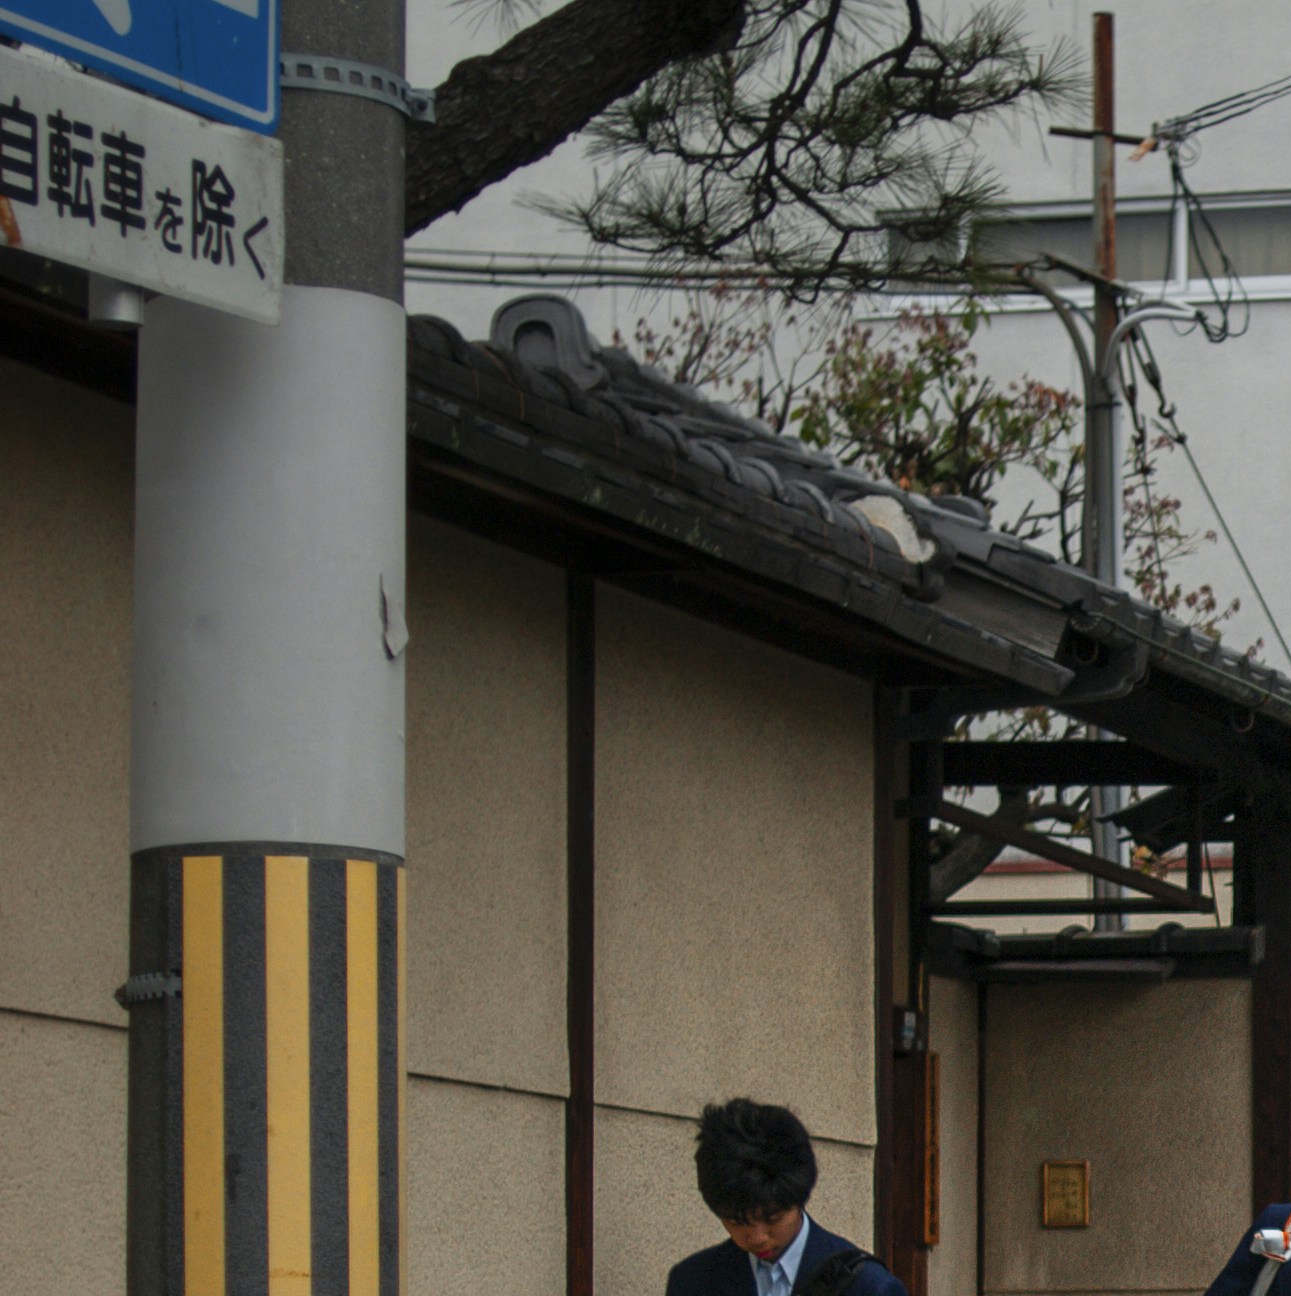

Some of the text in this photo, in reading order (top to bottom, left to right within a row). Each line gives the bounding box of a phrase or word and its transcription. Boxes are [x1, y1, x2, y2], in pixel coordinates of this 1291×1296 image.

[0, 95, 269, 281] 自転車を除く
